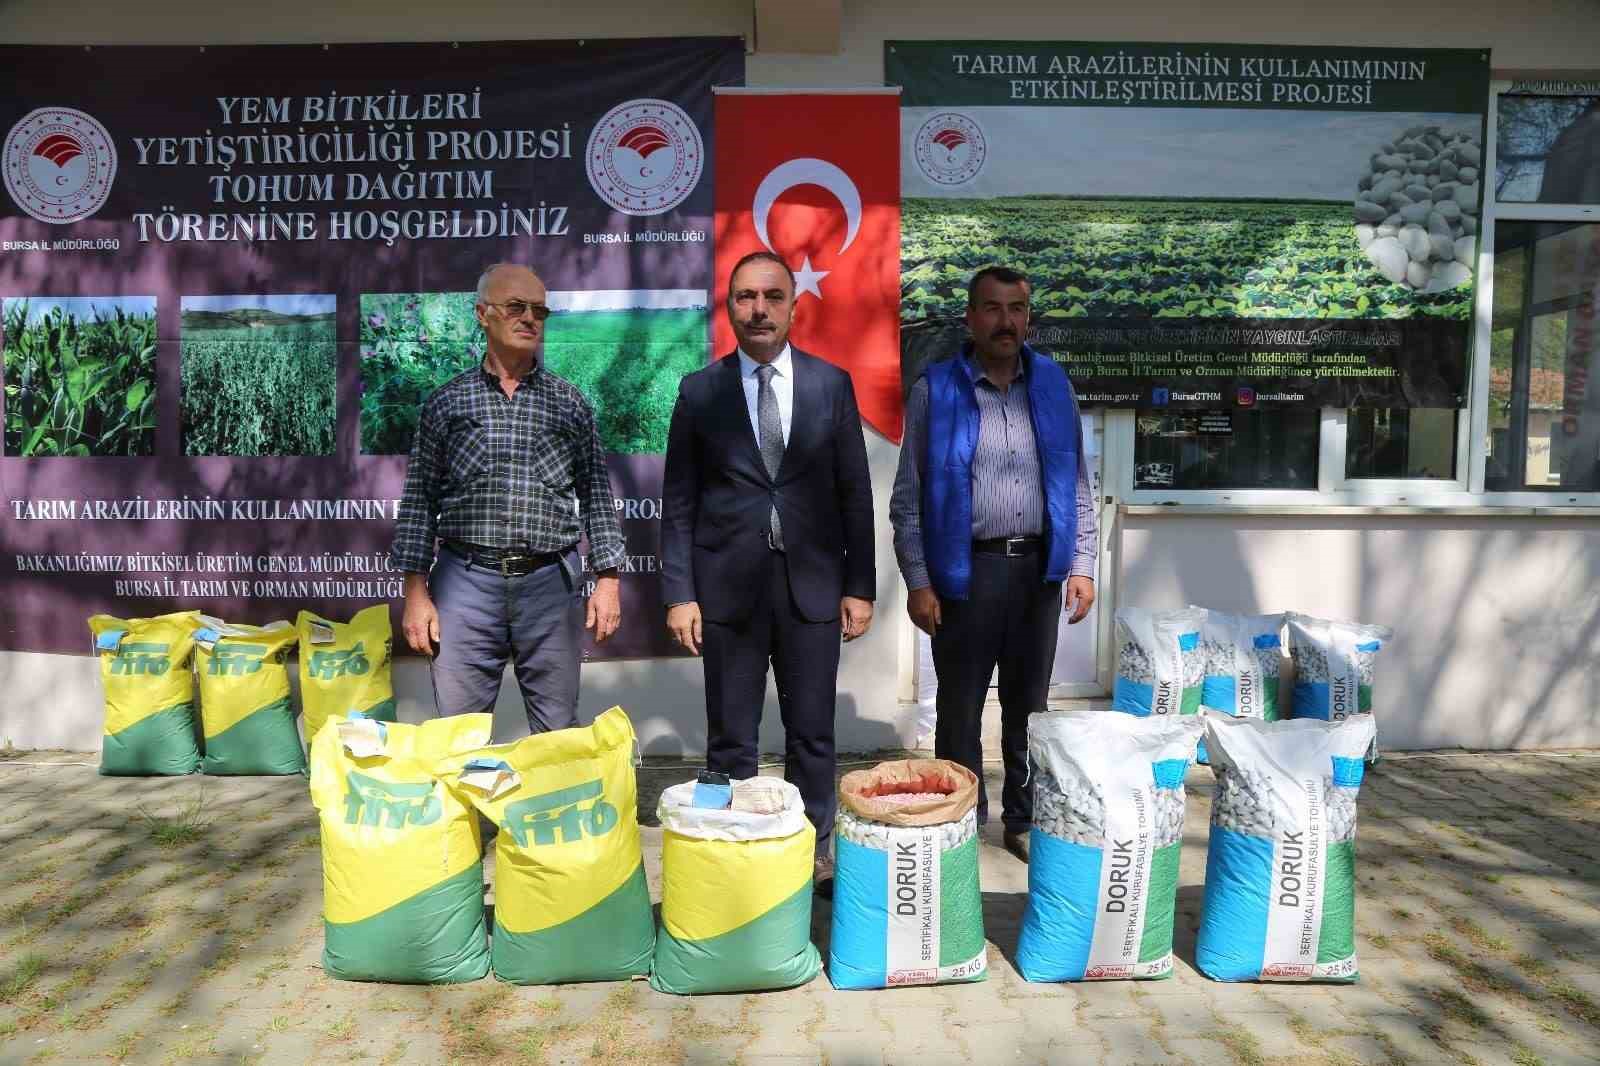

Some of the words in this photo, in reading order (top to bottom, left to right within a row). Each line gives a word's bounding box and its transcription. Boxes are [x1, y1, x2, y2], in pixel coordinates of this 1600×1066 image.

[951, 55, 1038, 74] TARIM
[1047, 50, 1231, 77] ARAZİLERİNİN
[1239, 57, 1427, 81] KULLANIMININ
[216, 96, 292, 125] YEM
[301, 86, 482, 123] BİTKİLERİ
[1009, 75, 1264, 105] ETKİNLEŞTİRİLMESİ
[1272, 80, 1373, 105] PROJESİ
[132, 122, 417, 172] YETİŞTİRİCİLİĞİ
[426, 122, 573, 161] PROJESİ
[208, 173, 336, 204] TOHUM
[345, 164, 495, 201] DAĞITIM
[131, 205, 319, 243] TÖRENİNE
[327, 200, 570, 247] HOŞGELDİNİZ
[583, 233, 622, 244] BURSA
[634, 230, 706, 243] MÜDÜRLÜĞÜ
[2, 241, 40, 251] BURSA
[52, 238, 120, 251] MÜDÜRLÜĞÜ
[1179, 368, 1193, 377] ve
[11, 499, 76, 520] TARIM
[79, 495, 226, 520] ARAZİLERİNİN
[230, 498, 385, 520] KULLANIMININ
[614, 498, 663, 520] PROJ
[15, 551, 124, 573] BAKANLIĞIMIZ
[126, 551, 194, 573] BİTKİSEL
[194, 551, 252, 573] ÜRETİM
[256, 555, 307, 574] GENEL
[115, 579, 161, 598] BURSA
[162, 576, 179, 598] İL
[180, 578, 229, 598] TARIM
[231, 578, 251, 598] VE
[253, 578, 312, 598] ORMAN
[312, 576, 406, 599] MÜDÜRLÜĞÜ
[1155, 680, 1172, 716] ORUK
[1240, 669, 1253, 714] DORUK
[896, 841, 918, 916] DORUK
[1105, 838, 1134, 914] DORUK
[1279, 830, 1304, 908] DORUK
[951, 966, 966, 978] 25
[967, 958, 981, 974] KG
[1326, 965, 1340, 976] 25
